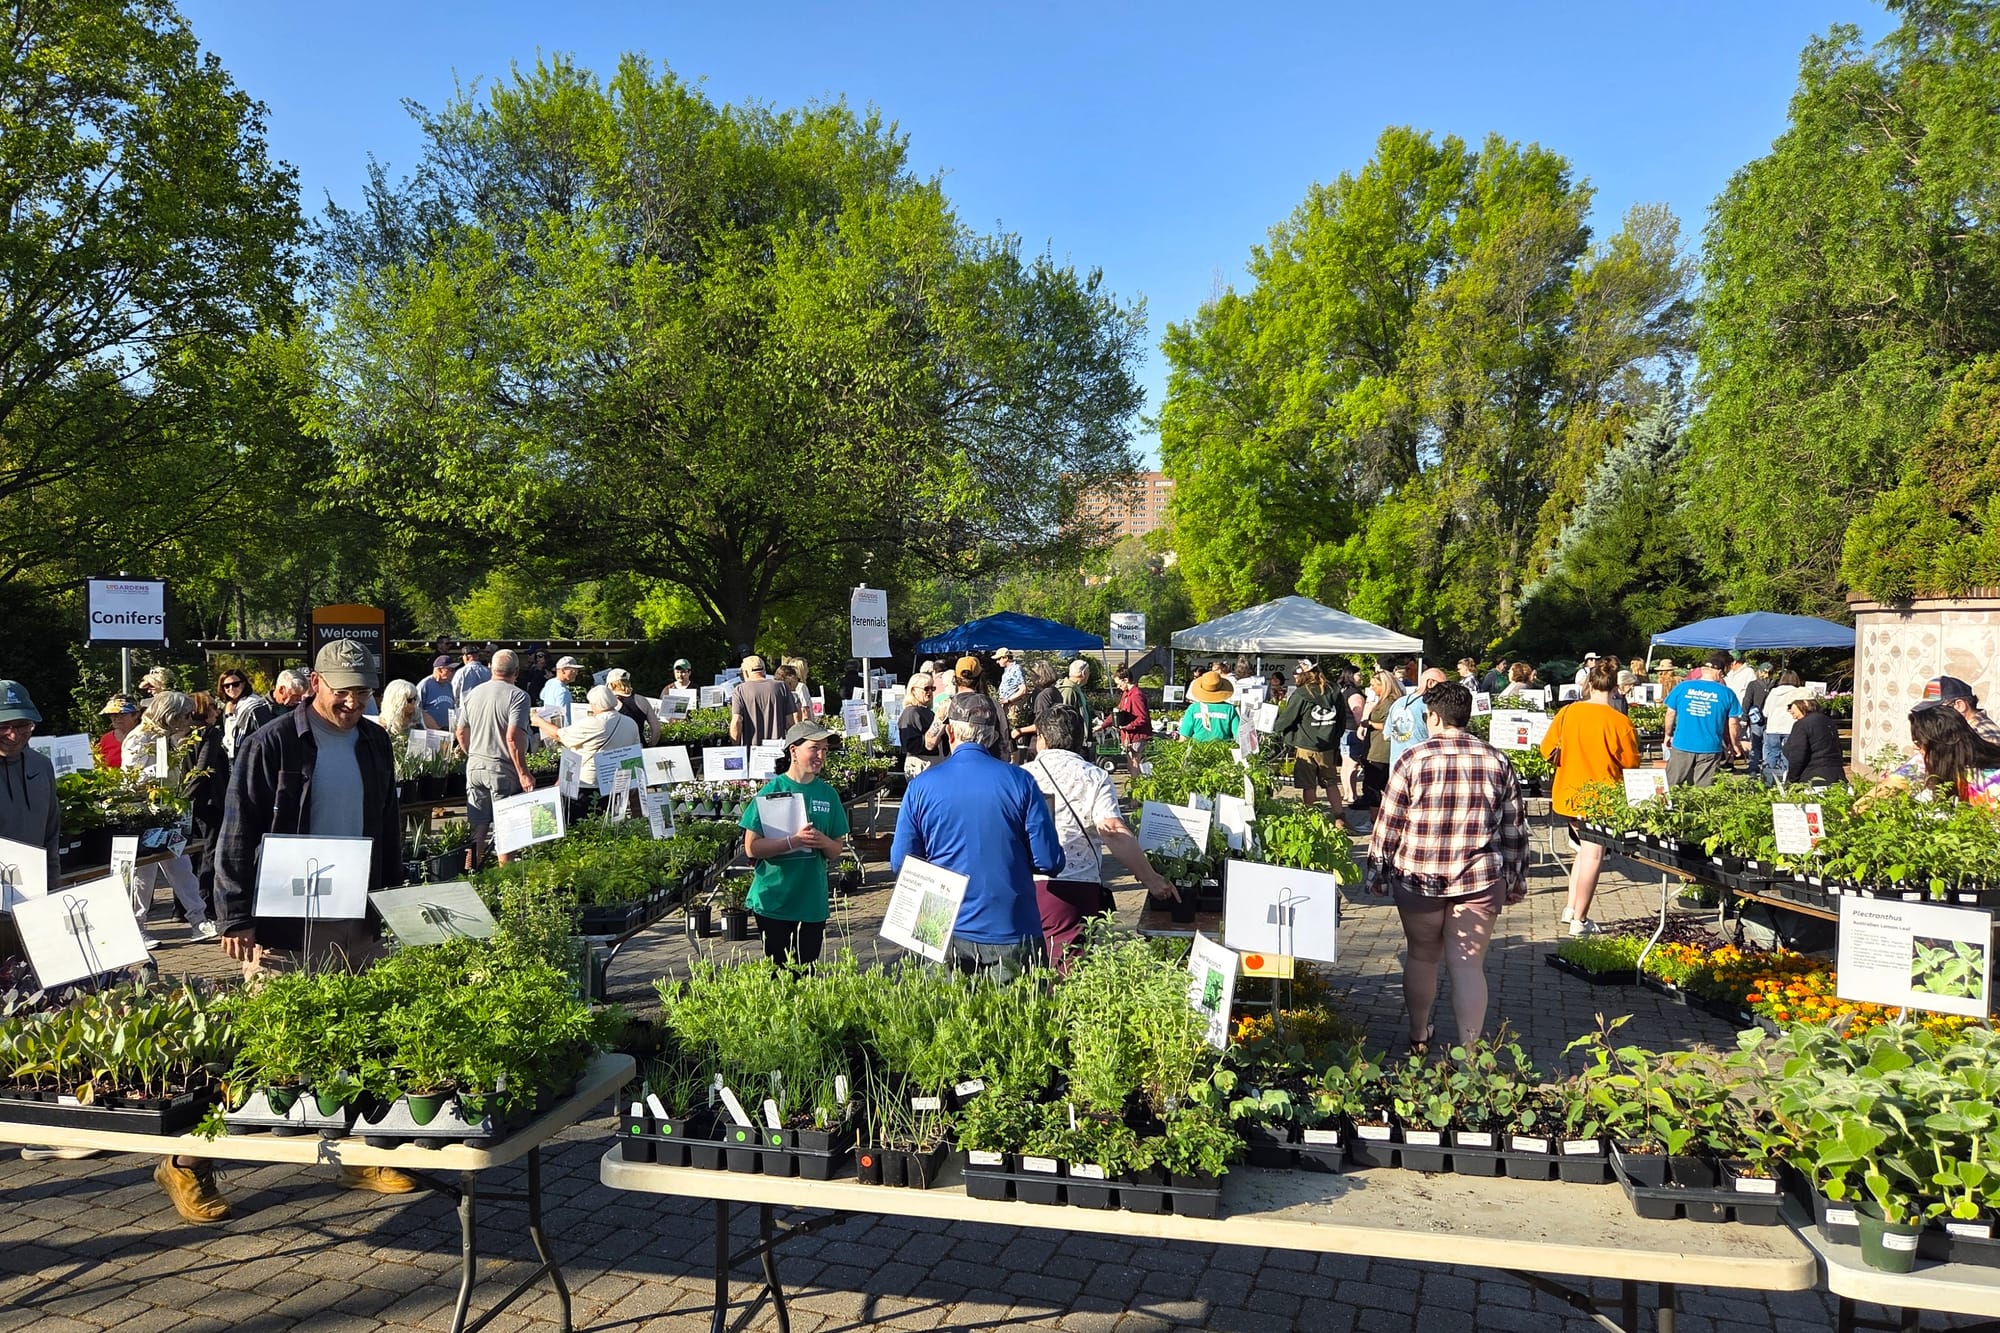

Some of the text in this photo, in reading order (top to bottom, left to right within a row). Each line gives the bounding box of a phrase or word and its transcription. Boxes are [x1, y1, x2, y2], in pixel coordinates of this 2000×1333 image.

[92, 611, 162, 624] Conifers
[852, 615, 887, 627] Perennials
[320, 627, 379, 638] Welcome
[1852, 910, 1903, 922] Plectranthus
